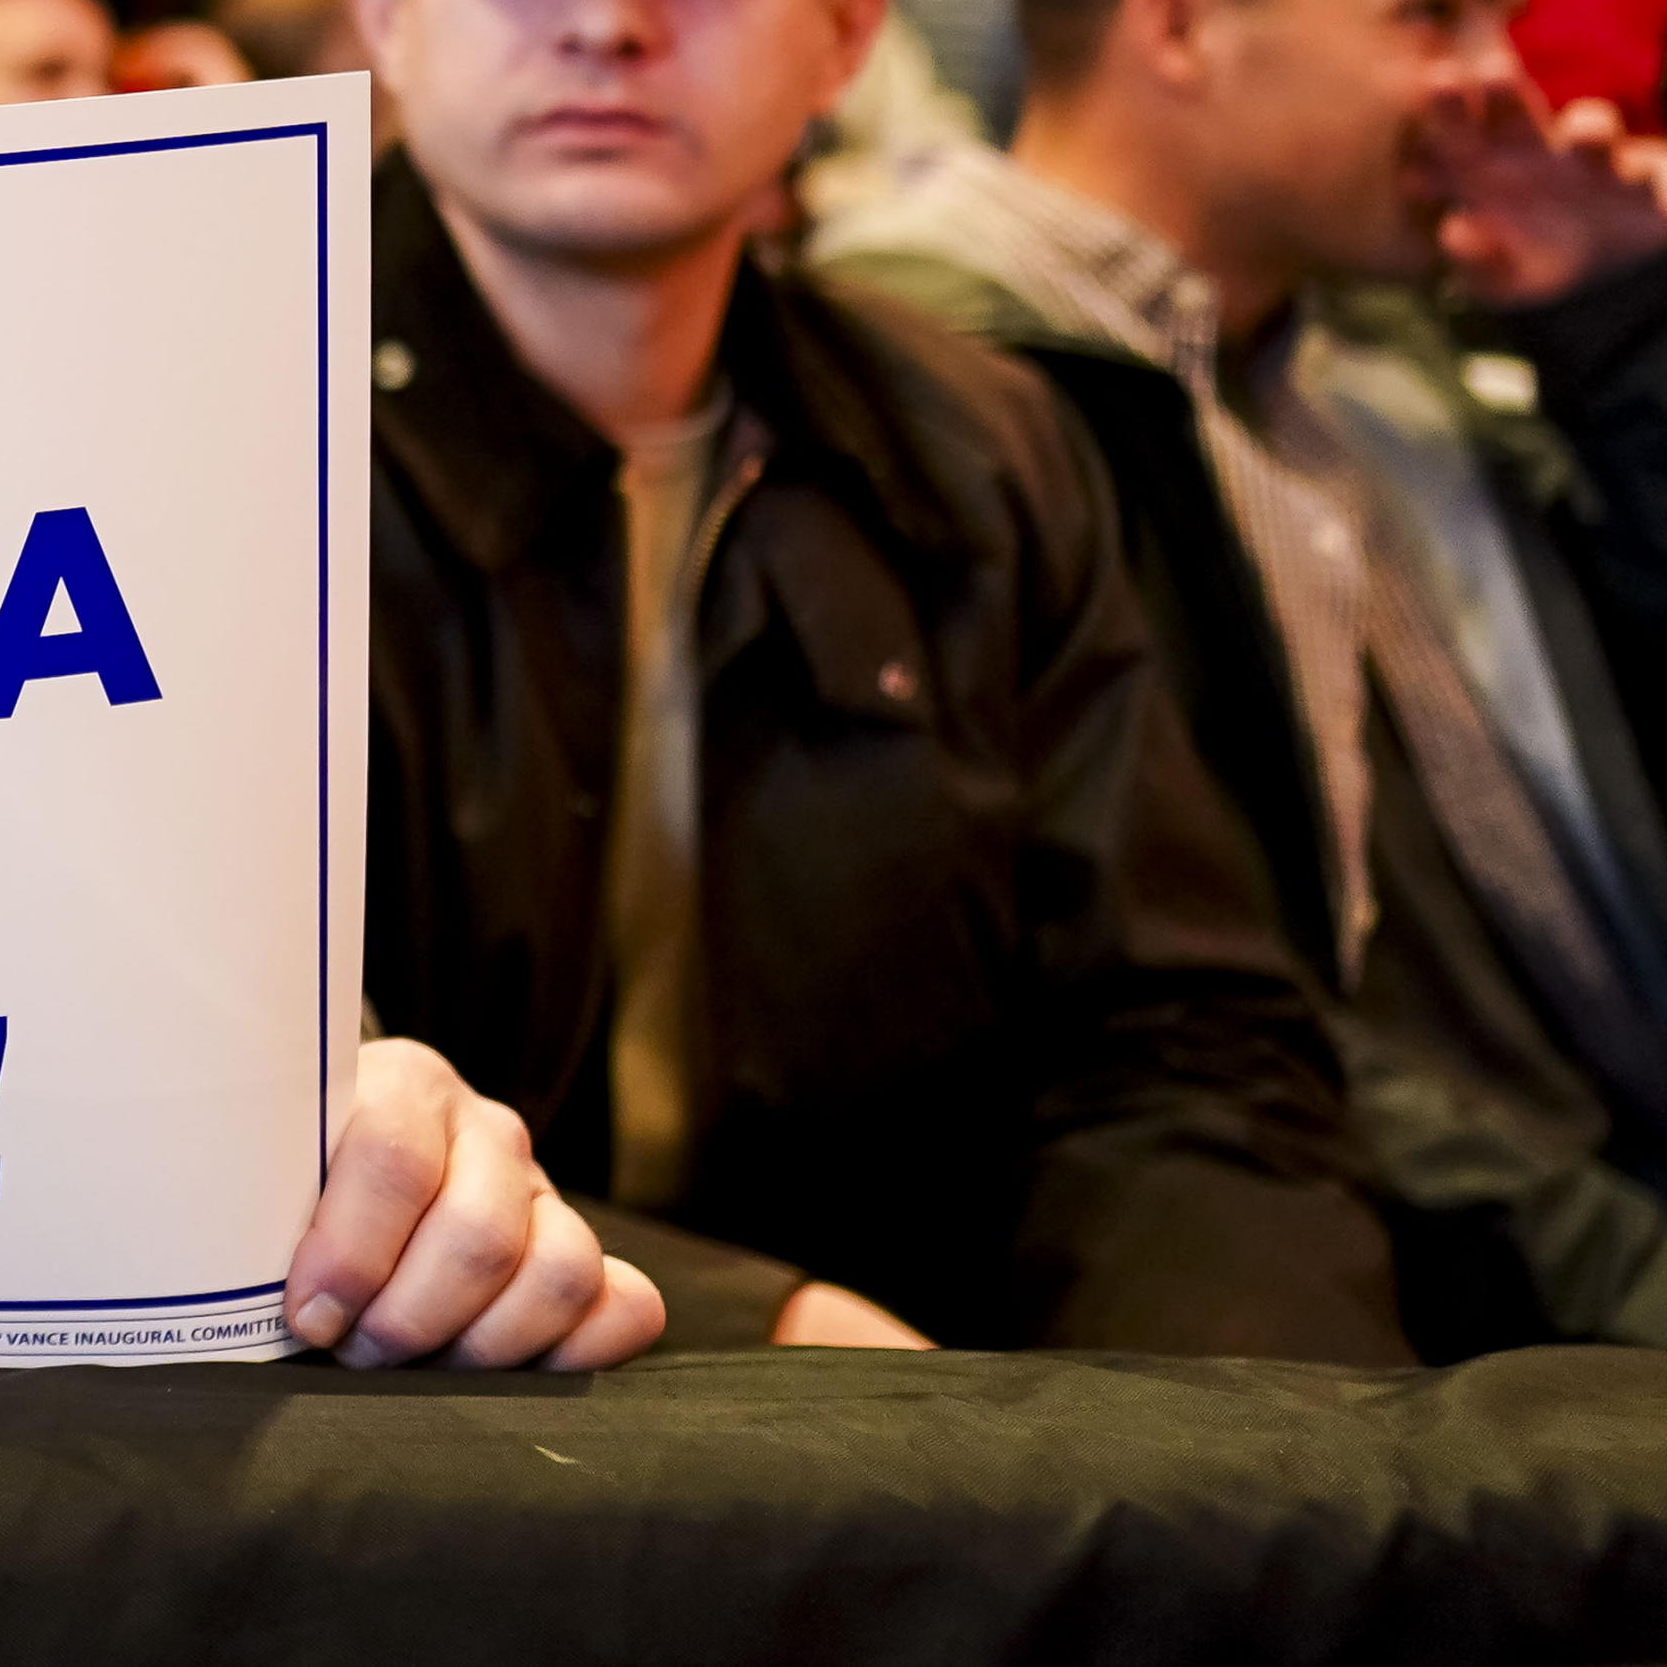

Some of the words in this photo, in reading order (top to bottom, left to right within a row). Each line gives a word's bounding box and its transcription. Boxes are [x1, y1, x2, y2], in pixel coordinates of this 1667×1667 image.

[6, 1331, 69, 1346] VANCE
[74, 1328, 187, 1346] INAUGURAL
[191, 1314, 292, 1343] COMMITTE
